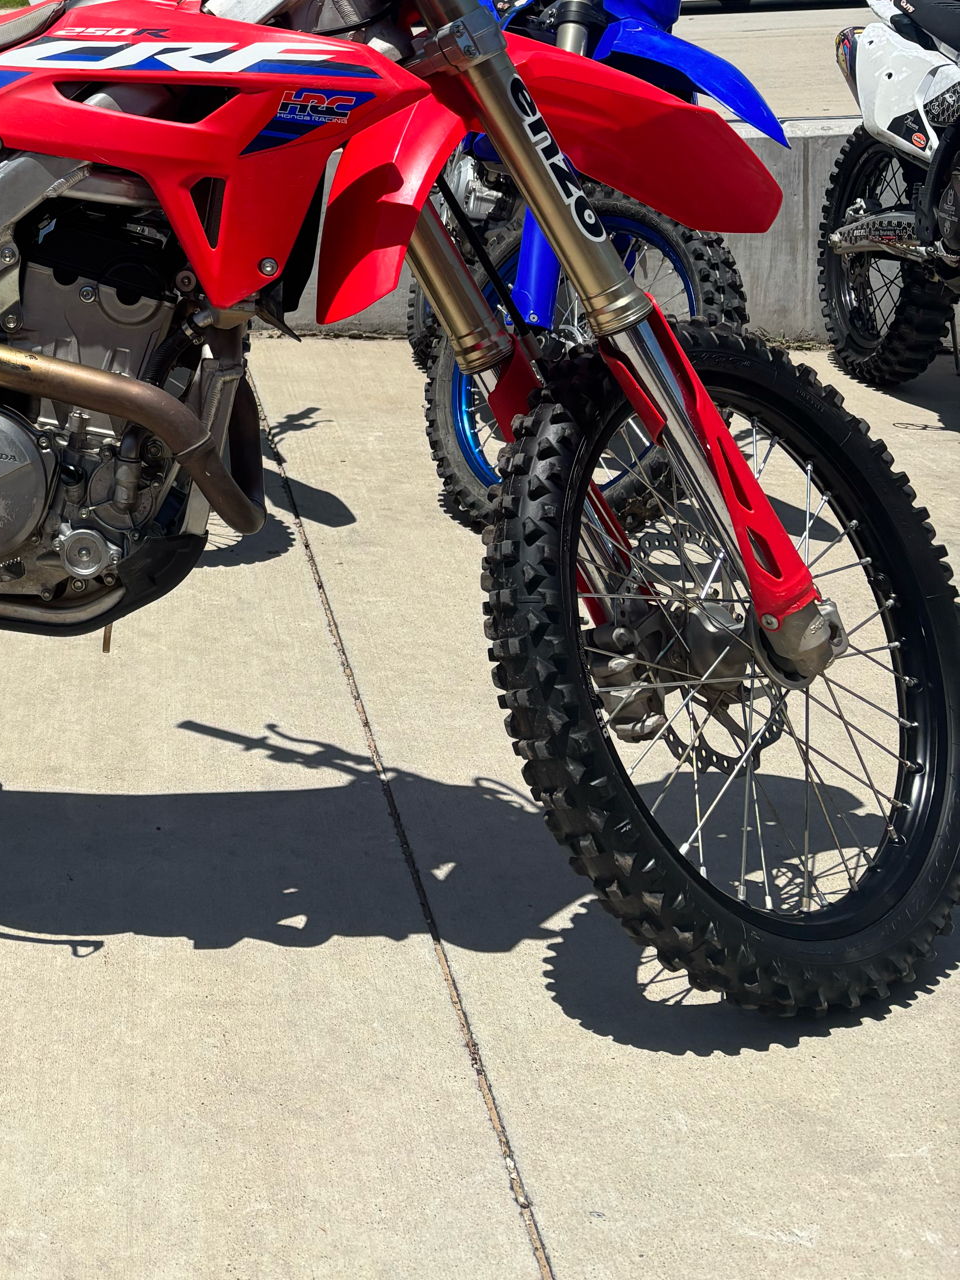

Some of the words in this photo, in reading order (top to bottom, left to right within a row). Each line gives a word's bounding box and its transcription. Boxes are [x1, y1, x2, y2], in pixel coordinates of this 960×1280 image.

[53, 27, 171, 39] 250R
[277, 90, 356, 118] HRC
[276, 112, 311, 121] Honda
[312, 116, 348, 125] RACING
[507, 73, 607, 243] enzo
